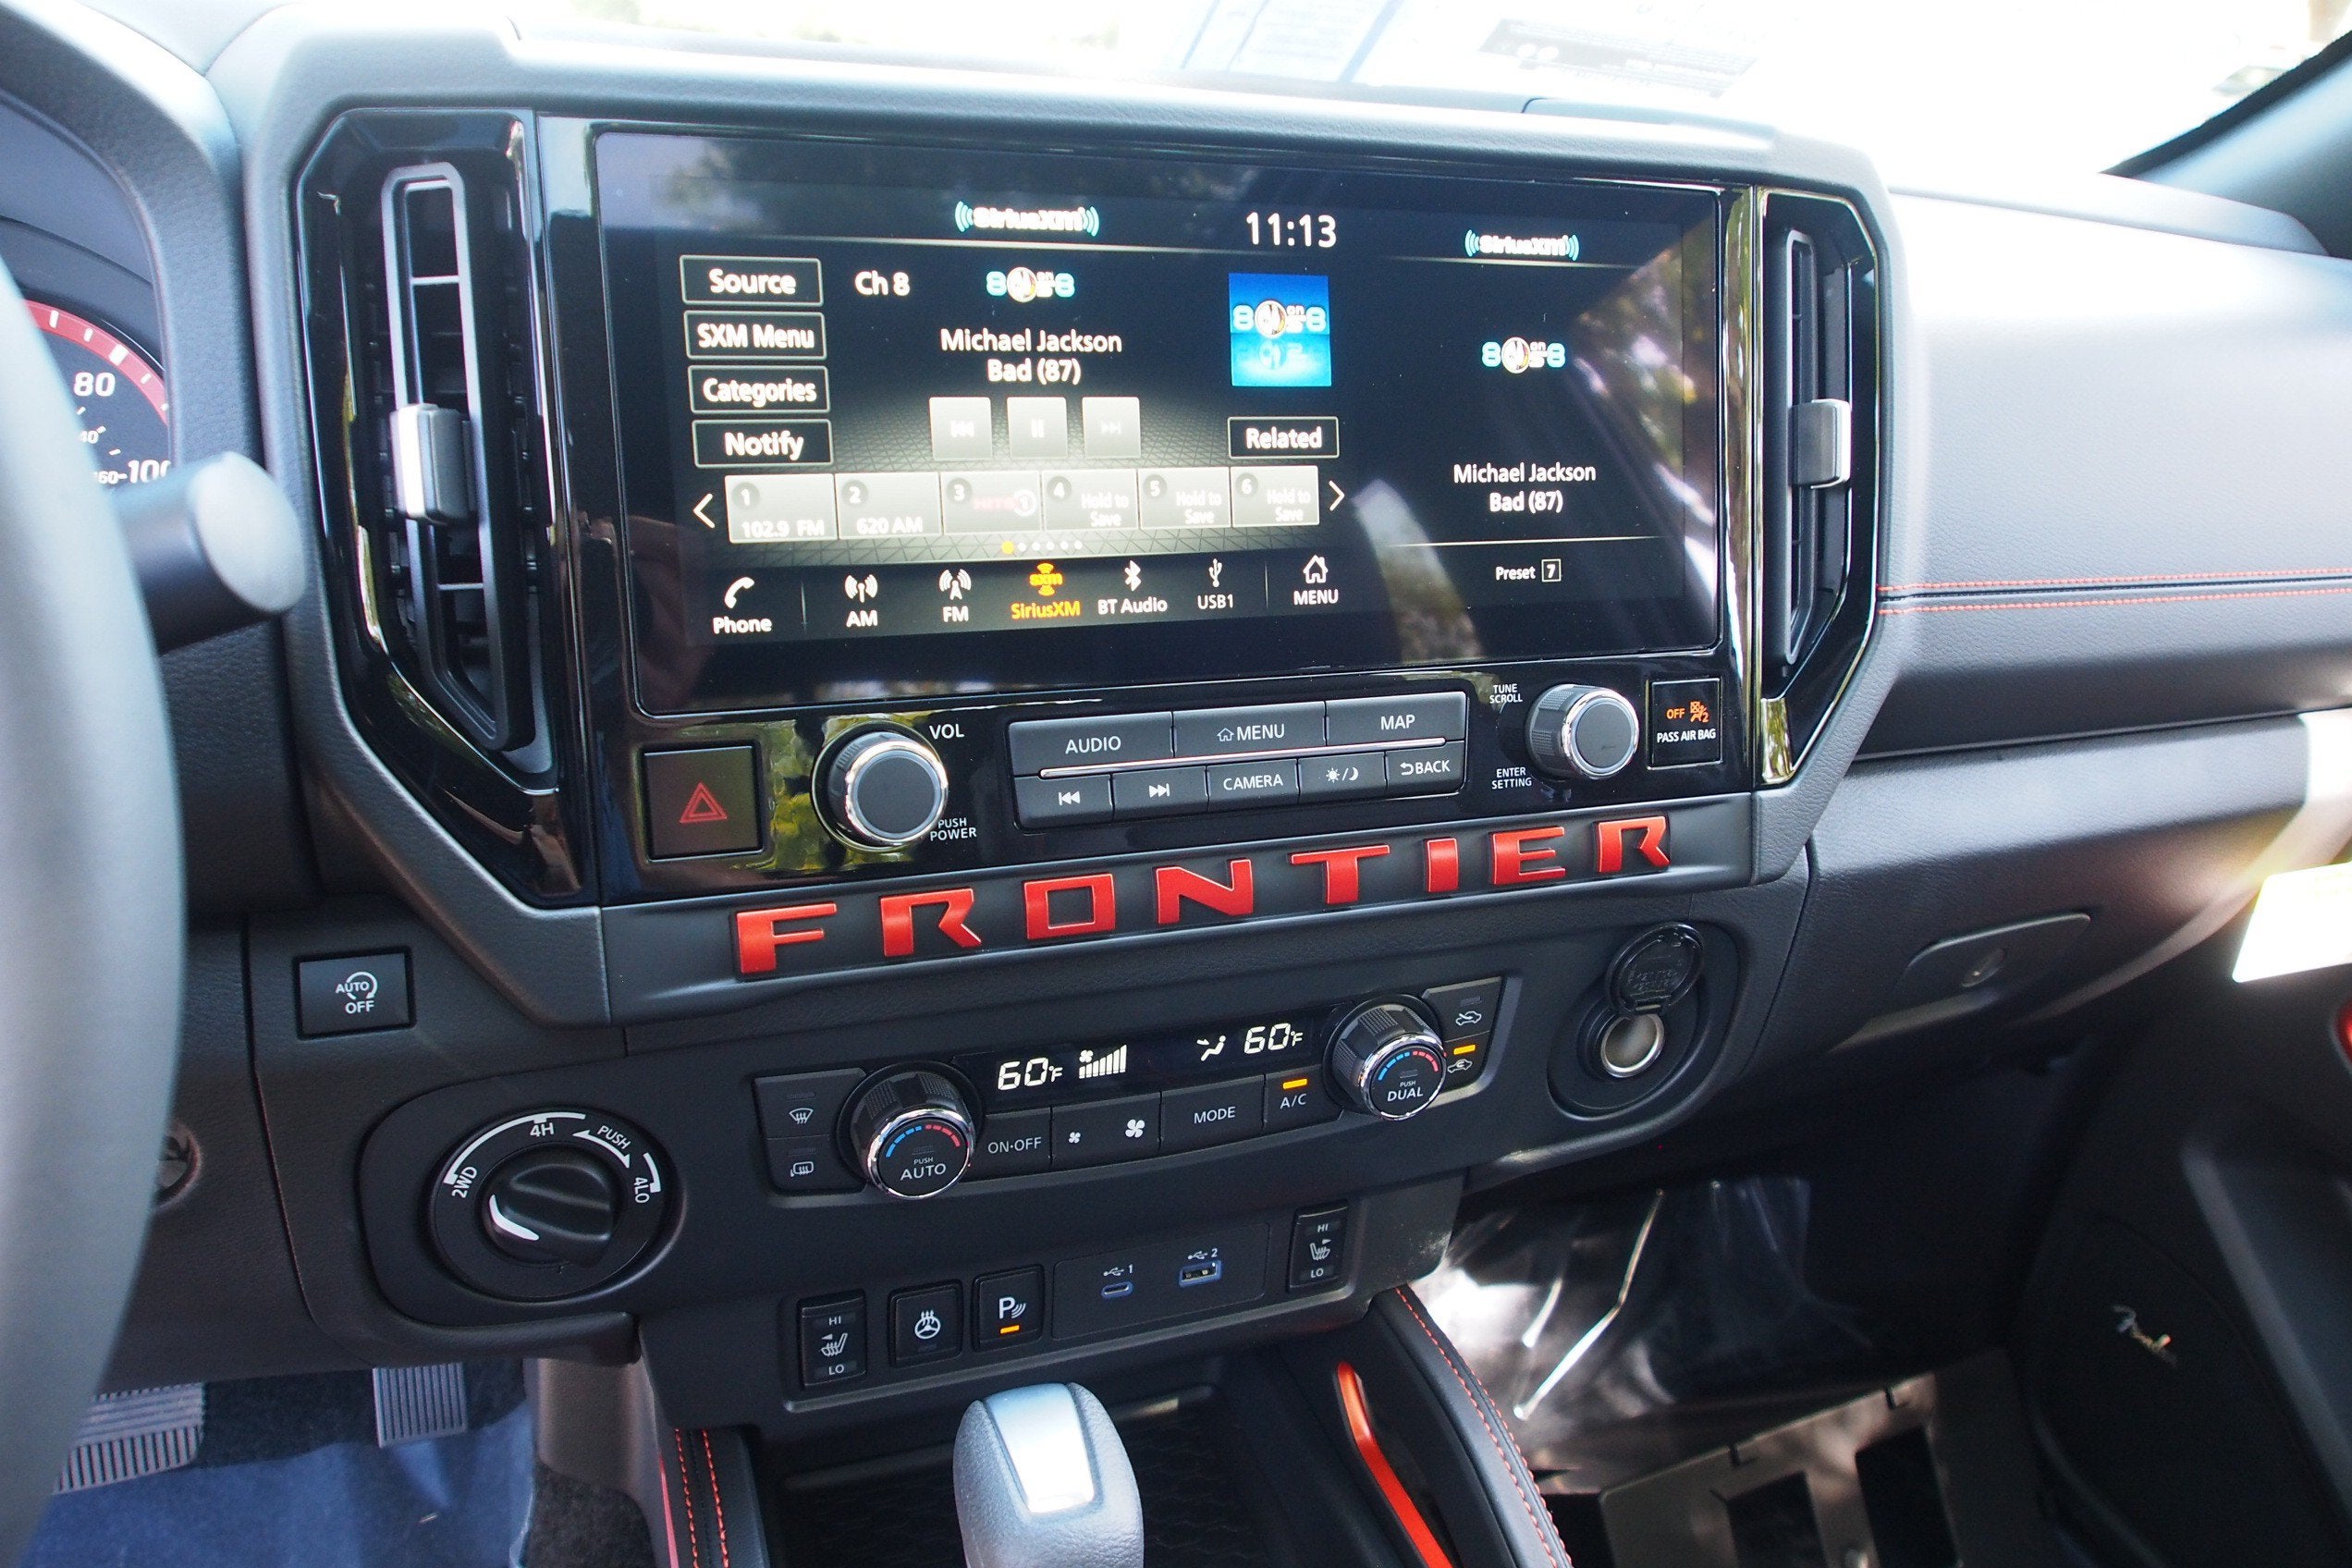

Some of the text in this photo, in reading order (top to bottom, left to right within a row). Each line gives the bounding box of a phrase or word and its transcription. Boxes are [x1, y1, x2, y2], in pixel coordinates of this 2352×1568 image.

[1245, 212, 1337, 248] 11:13
[709, 269, 796, 295] Source
[855, 271, 911, 297] Ch 8
[698, 324, 815, 349] SXM Menu
[941, 328, 1122, 354] Michael Jackson
[988, 359, 1082, 385] Bad (87)
[74, 372, 116, 397] 80
[703, 378, 817, 408] Categories
[725, 431, 803, 460] Notify
[1245, 427, 1322, 450] Related
[1453, 462, 1597, 484] Michael Jackson
[849, 485, 863, 504] 2
[954, 484, 966, 502] 3
[1053, 482, 1065, 499] 4
[1150, 478, 1161, 496] 5
[1241, 476, 1252, 495] 6
[740, 488, 751, 506] 1
[1082, 493, 1130, 510] Hold to
[1176, 490, 1222, 508] Hold to
[1267, 488, 1312, 505] Hold to
[1488, 492, 1563, 514] Bad (87)
[741, 518, 826, 539] 102.9 FM
[856, 516, 924, 535] 620 AM
[1090, 511, 1122, 528] Save
[1495, 563, 1556, 581] Preset 7
[1097, 595, 1169, 617] BT Audio
[1197, 594, 1234, 610] USB1
[1293, 588, 1339, 606] MENU
[942, 606, 969, 623] FM
[1011, 600, 1081, 619] SiriusXM
[713, 615, 772, 634] Phone
[846, 610, 879, 629] AM
[1493, 683, 1518, 693] TUNE
[1489, 692, 1523, 704] SCROLL
[1666, 707, 1685, 719] OFF
[1380, 715, 1415, 730] MAP
[929, 724, 964, 740] VOL
[1237, 723, 1285, 741] MENU
[1657, 729, 1716, 743] PASS AIR BAG
[1065, 736, 1121, 754] AUDIO
[1415, 760, 1451, 775] BACK
[1496, 766, 1525, 778] ENTER
[1223, 773, 1283, 790] CAMERA
[1492, 778, 1532, 790] SETTING
[938, 817, 967, 829] PUSH
[930, 827, 977, 841] POWER
[736, 816, 1670, 974] FRONTIER
[336, 981, 370, 994] AUTO
[345, 1000, 374, 1014] OFF
[1400, 1080, 1416, 1088] PUSH
[1280, 1093, 1306, 1109] A/C
[1388, 1086, 1424, 1102] DUAL
[1194, 1106, 1236, 1124] MODE
[530, 1122, 555, 1137] 4H
[597, 1125, 631, 1150] PUSH
[913, 1157, 934, 1165] PUSH
[900, 1163, 947, 1181] AUTO
[451, 1165, 478, 1199] 2WD
[633, 1176, 650, 1204] 4LO
[1317, 1222, 1329, 1233] HI
[1211, 1248, 1219, 1257] 2
[1310, 1268, 1325, 1280] LO
[828, 1315, 842, 1326] HI
[828, 1364, 845, 1376] LO
